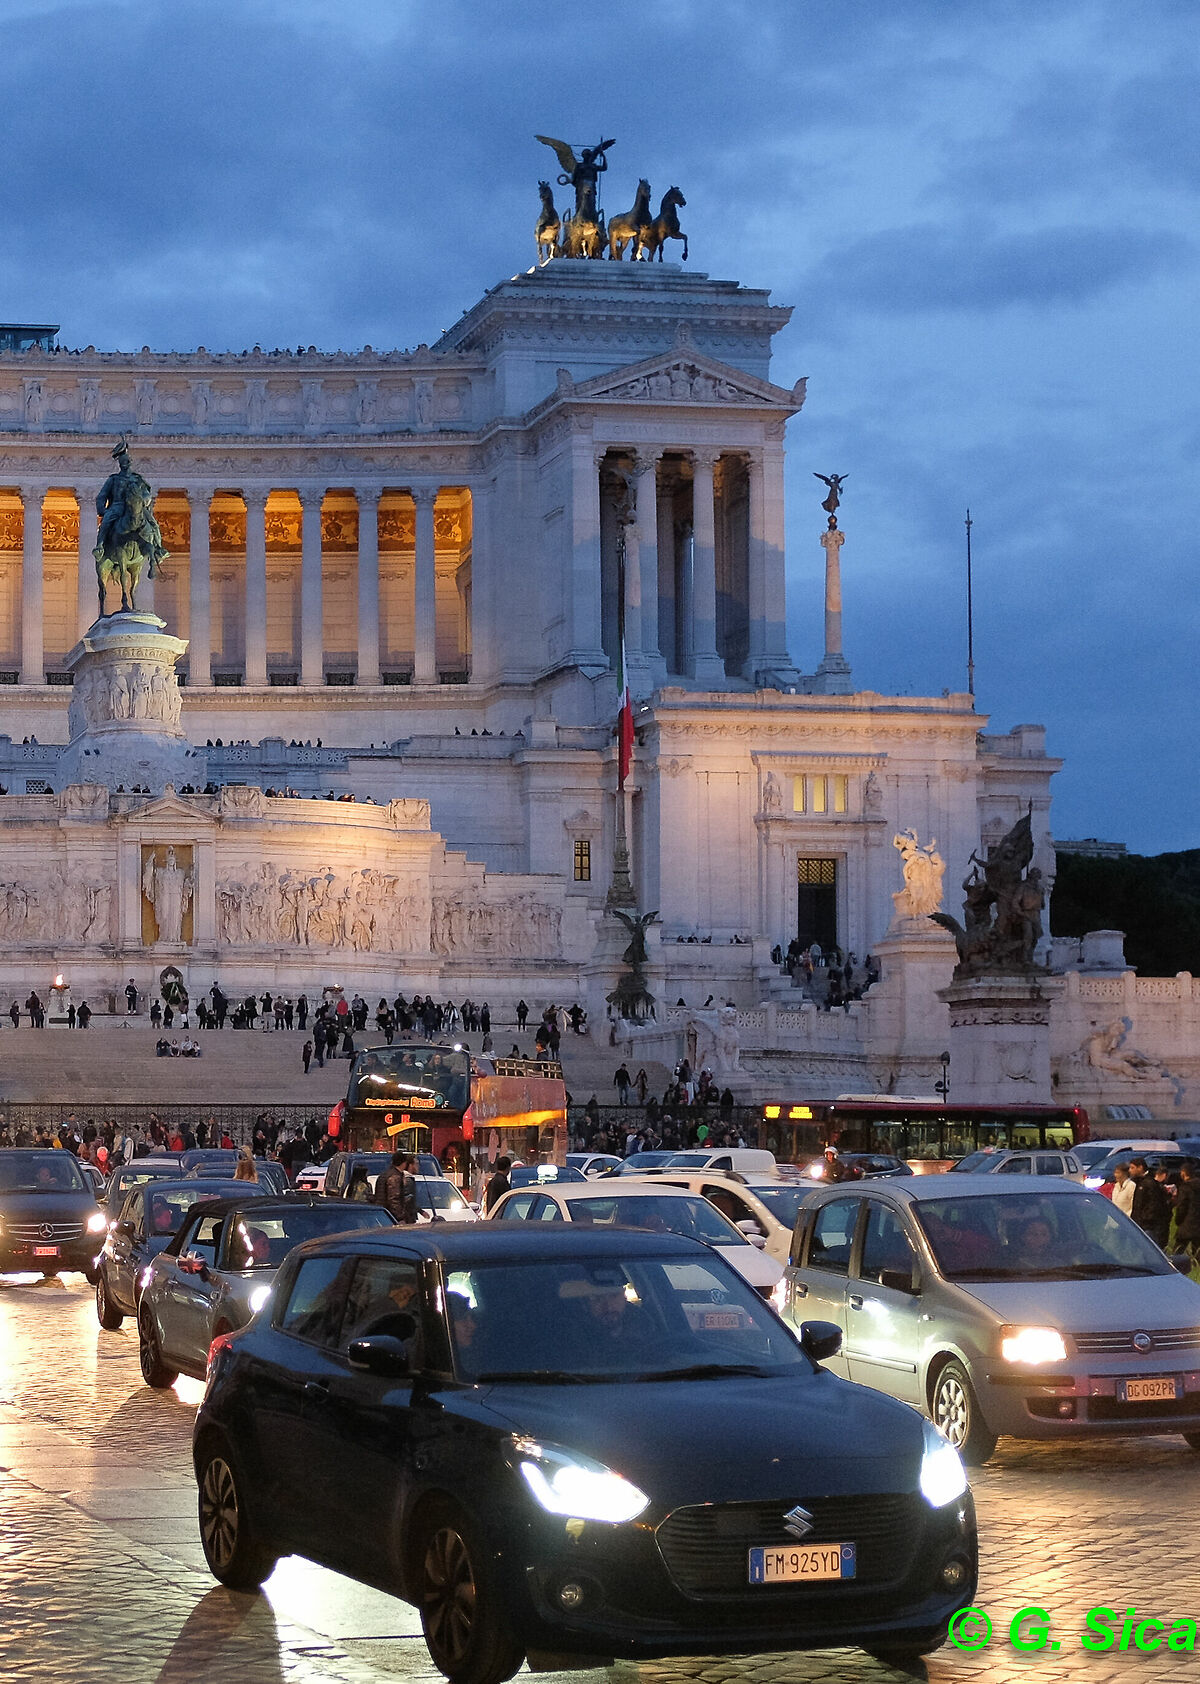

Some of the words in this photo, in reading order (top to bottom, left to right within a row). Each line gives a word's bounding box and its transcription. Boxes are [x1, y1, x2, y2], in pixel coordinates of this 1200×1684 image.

[1142, 1382, 1175, 1397] 092PR
[765, 1553, 785, 1576] FM
[790, 1551, 840, 1574] 925YD
